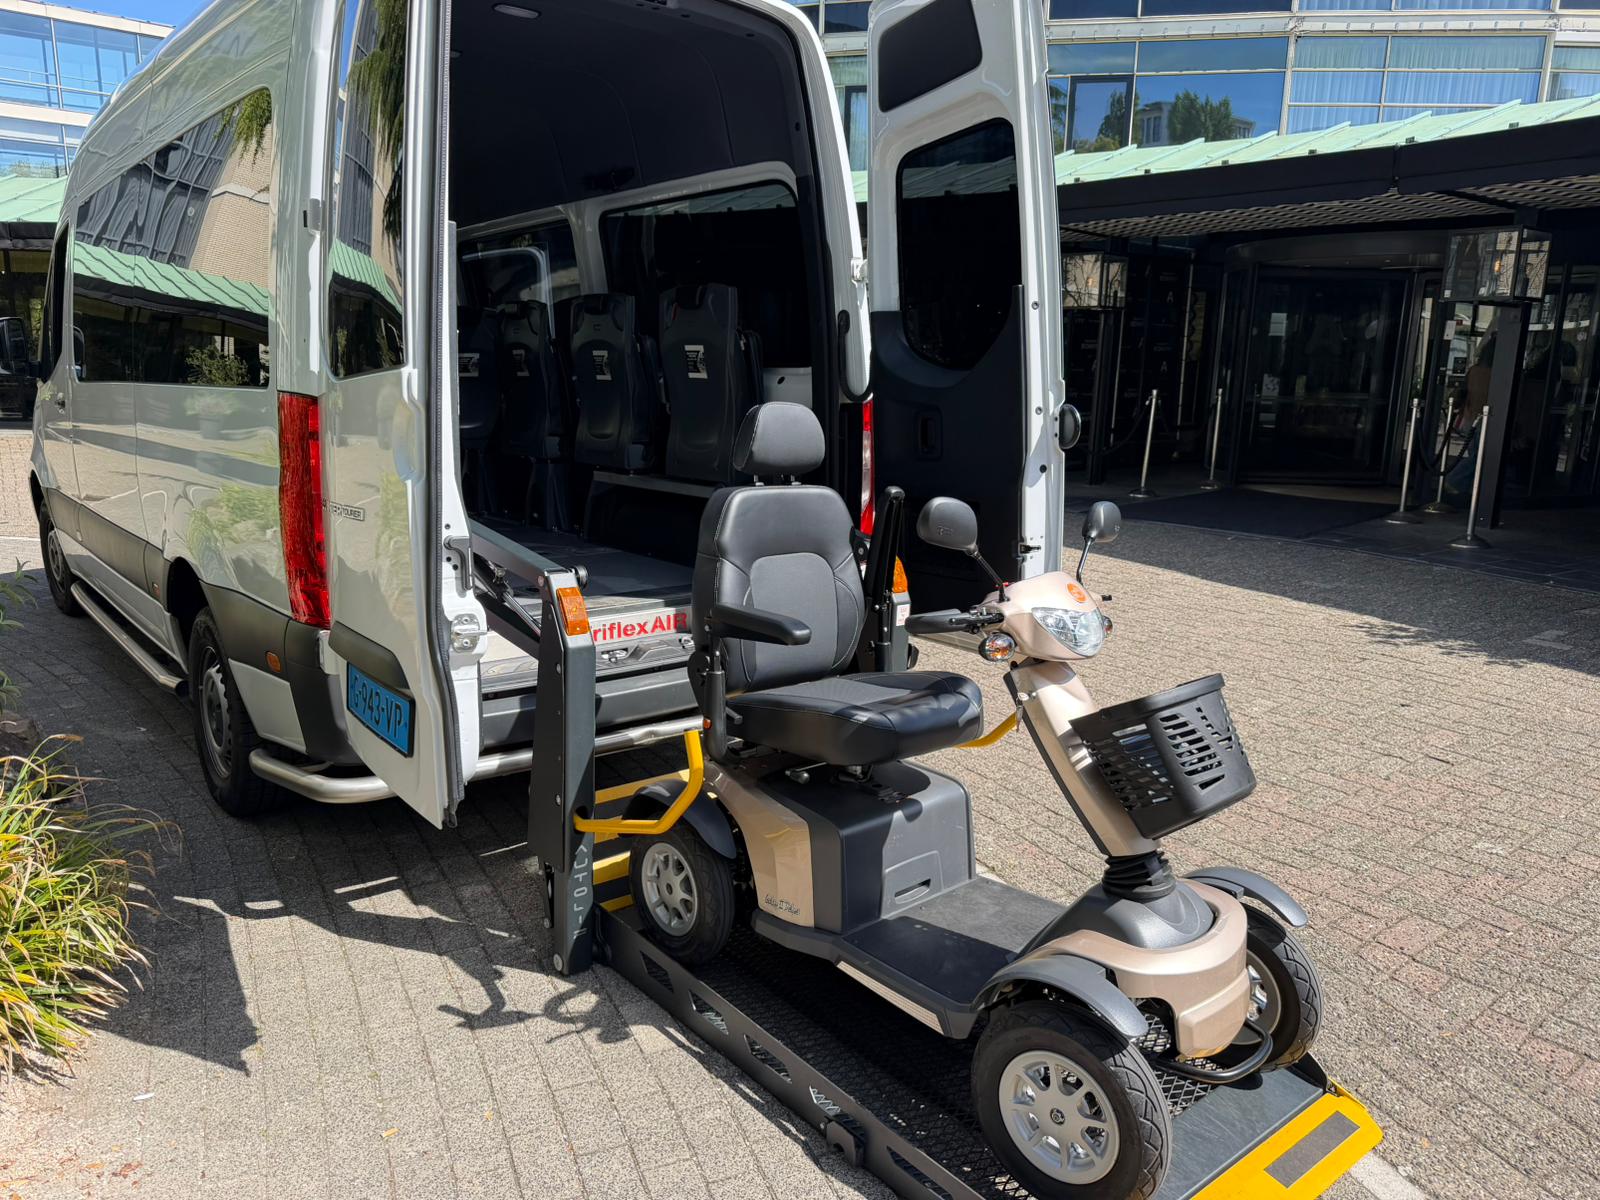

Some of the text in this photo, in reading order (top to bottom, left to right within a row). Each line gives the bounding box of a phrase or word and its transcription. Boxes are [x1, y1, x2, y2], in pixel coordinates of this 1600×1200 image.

[590, 612, 688, 642] riflex AIR
[351, 673, 403, 738] G-943-VP
